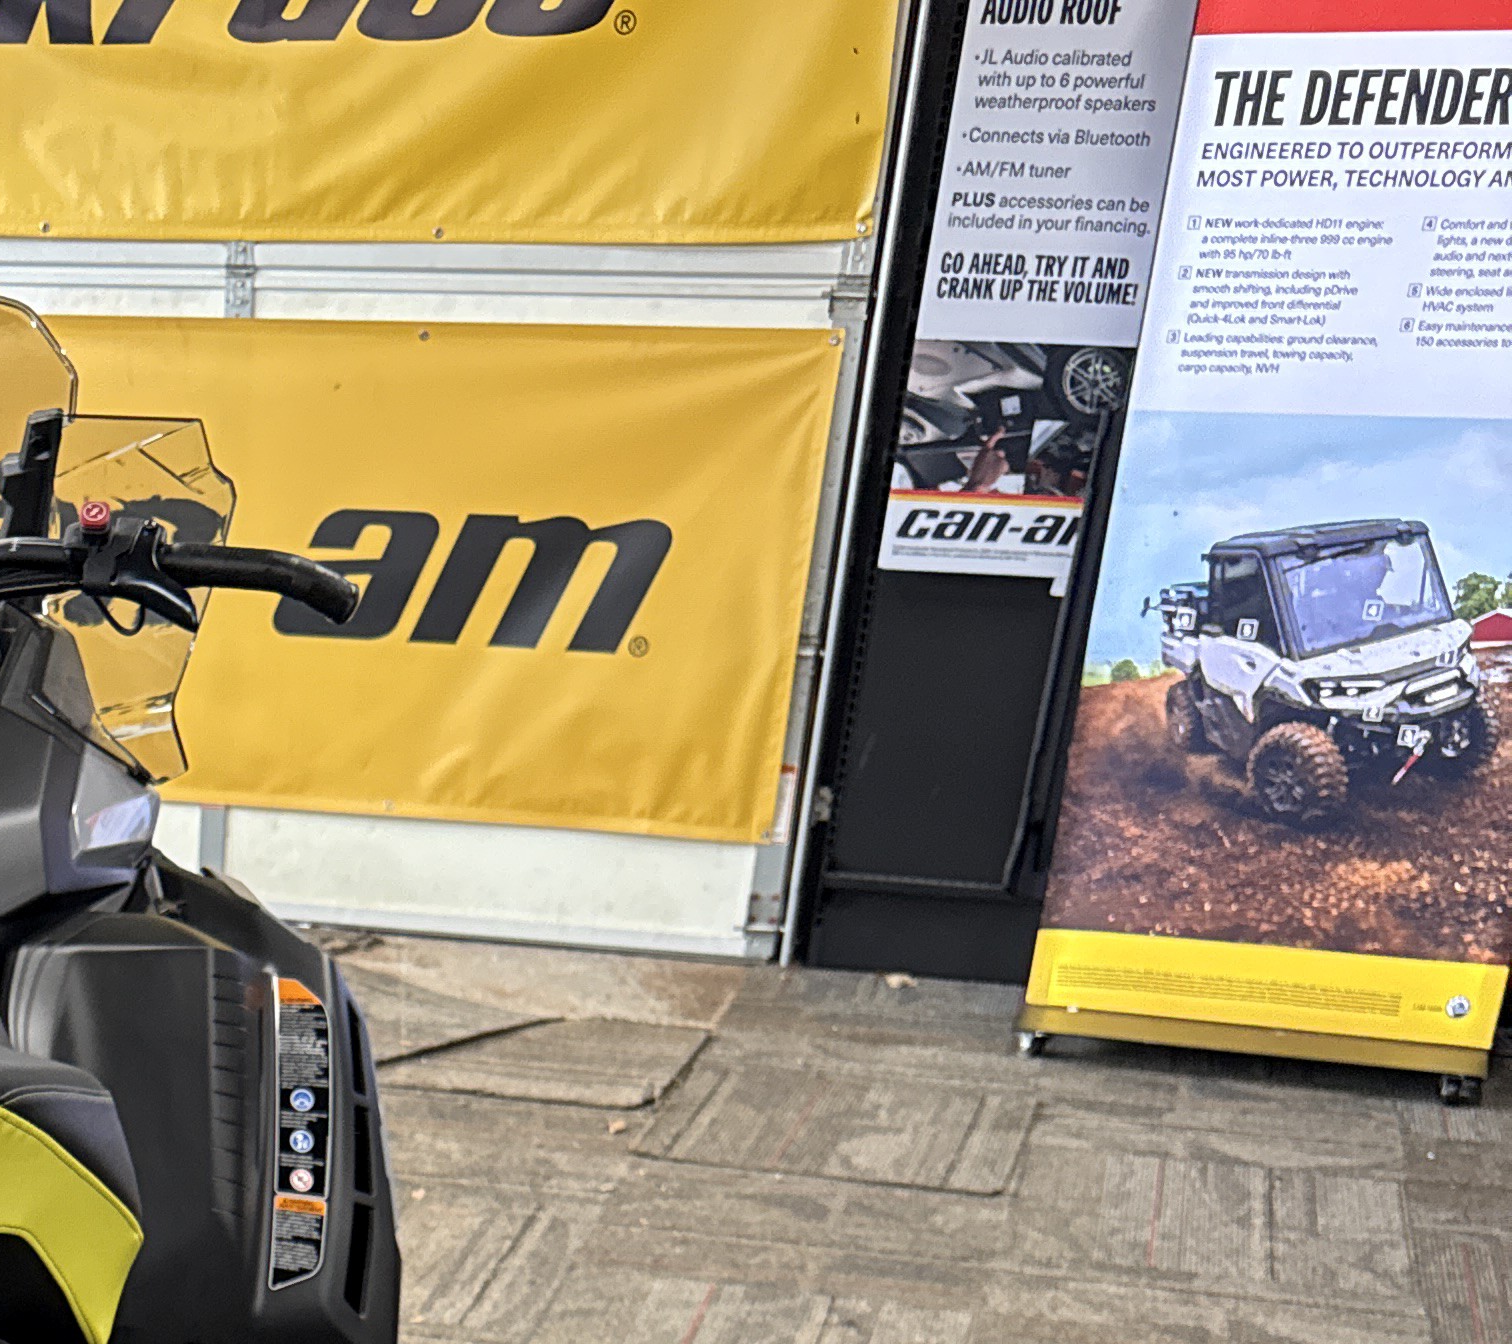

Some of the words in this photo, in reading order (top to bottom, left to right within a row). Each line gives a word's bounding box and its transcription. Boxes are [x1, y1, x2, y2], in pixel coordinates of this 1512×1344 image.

[980, 0, 1053, 25] AUDIO
[1001, 49, 1048, 66] Audio
[1052, 51, 1133, 67] calibrated
[978, 72, 1011, 88] with
[1016, 75, 1036, 91] up
[1040, 74, 1055, 88] to
[1059, 73, 1070, 88] 6
[1073, 73, 1145, 91] powerful
[974, 93, 1081, 113] weatherproof
[1084, 96, 1156, 114] speakers
[1214, 69, 1293, 127] THE
[1299, 67, 1512, 126] DEFENDER
[968, 127, 1044, 145] Connects
[1048, 129, 1070, 145] via
[1074, 129, 1151, 147] Bluetooth
[1201, 142, 1332, 160] ENGINEERED
[1337, 142, 1364, 160] TO
[1369, 142, 1512, 160] OUTPERFORM
[962, 161, 1025, 178] AM/FM
[1028, 163, 1071, 179] tuner
[1196, 170, 1257, 188] MOST
[1260, 170, 1339, 191] POWER,
[1345, 170, 1487, 188] TECHNOLOGY
[951, 192, 996, 208] PLUS
[999, 194, 1093, 210] accessories
[1097, 198, 1125, 212] can
[1130, 197, 1150, 213] be
[947, 213, 1015, 229] included
[1018, 215, 1032, 230] in
[1034, 218, 1070, 238] your
[1075, 216, 1151, 237] financing.
[1205, 218, 1233, 229] NEW
[1234, 218, 1313, 229] work-dedicated
[1315, 218, 1343, 229] HD11
[940, 252, 964, 274] GO
[968, 252, 1028, 279] AHEAD,
[1035, 254, 1067, 277] TRY
[1072, 256, 1090, 278] IT
[1091, 257, 1129, 280] AND
[1195, 268, 1223, 279] NEW
[1225, 268, 1289, 280] transmission
[1291, 269, 1326, 281] design
[1328, 269, 1351, 280] with
[936, 277, 993, 299] CRANK
[1000, 278, 1024, 300] UP
[1027, 279, 1058, 302] THE
[1063, 281, 1138, 306] VOLUME!
